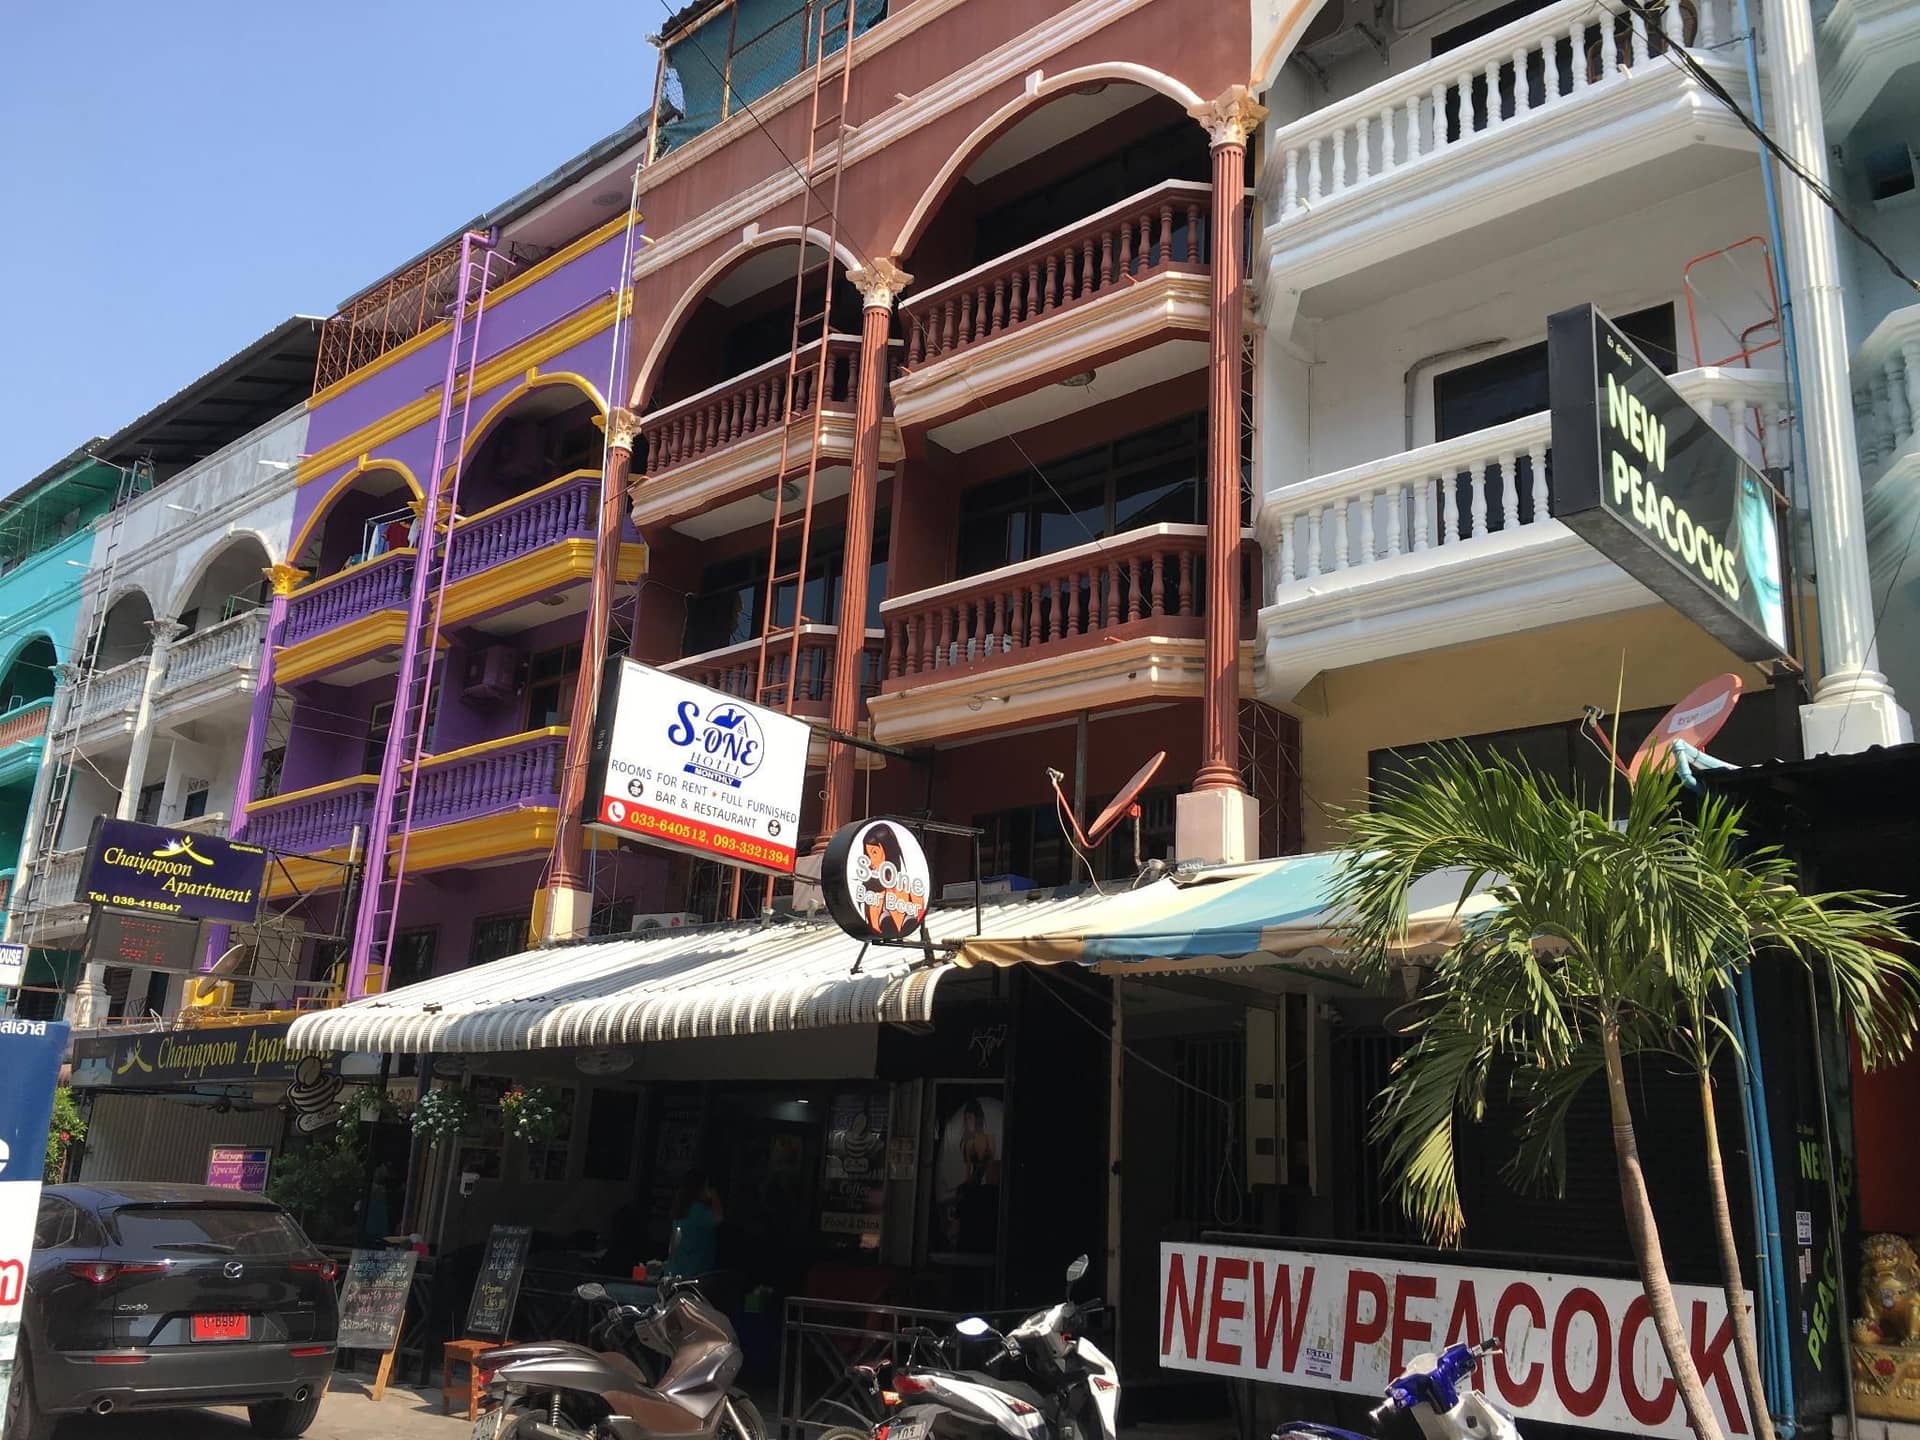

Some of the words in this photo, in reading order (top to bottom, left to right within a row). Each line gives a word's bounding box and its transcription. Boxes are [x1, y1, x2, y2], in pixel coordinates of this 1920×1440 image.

[1607, 372, 1667, 473] NEW
[1612, 450, 1740, 602] PEACOCKS
[668, 701, 759, 766] S-ONE
[611, 759, 652, 780] ROOMS
[656, 772, 677, 788] FOR
[681, 779, 708, 797] RENT
[721, 792, 743, 808] FULL
[747, 800, 797, 824] FURNISHED
[695, 767, 733, 785] MONTHLY
[655, 790, 677, 806] BAR
[681, 798, 688, 810] &
[693, 801, 757, 829] RESTAURANT
[104, 847, 193, 877] Chaiyapoon
[856, 855, 925, 897] S-One
[88, 891, 110, 903] Tel.
[113, 896, 181, 912] 038-415847
[162, 876, 252, 904] Apartment
[856, 885, 882, 907] Bar
[886, 892, 921, 917] Beer
[158, 1035, 238, 1078] Chaiyapoon
[1162, 1252, 1315, 1374] NEW
[1340, 1269, 1752, 1435] PEACOCK
